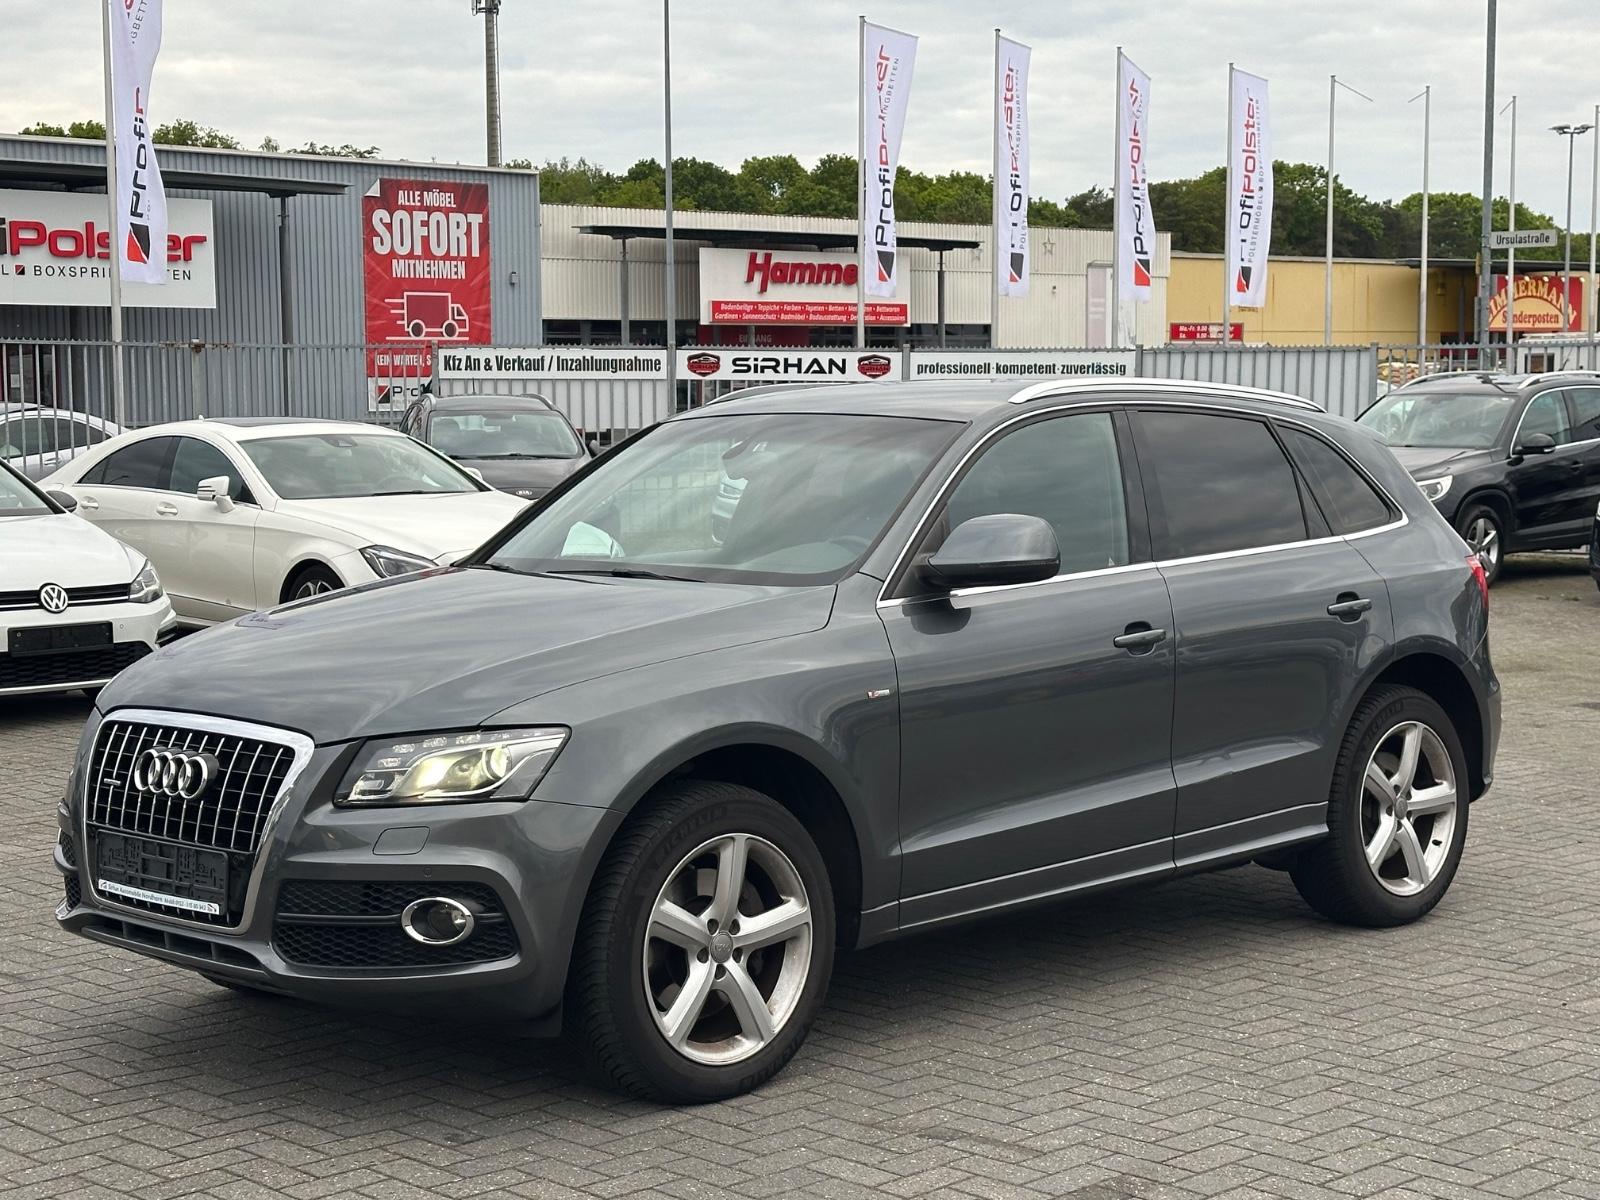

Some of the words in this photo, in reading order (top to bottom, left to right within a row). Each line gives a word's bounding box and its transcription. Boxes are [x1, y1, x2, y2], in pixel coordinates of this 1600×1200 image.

[398, 190, 421, 206] ALLE
[423, 188, 457, 208] MÖBEL
[372, 209, 483, 258] SOFORT
[1496, 232, 1551, 246] Ursulastraße
[391, 259, 466, 279] MITNEHMEN
[746, 251, 859, 293] Hamme
[714, 312, 739, 320] Gardinen
[757, 303, 780, 312] Teppiche
[1502, 311, 1559, 326] Snderposten
[443, 354, 462, 371] Kfz
[464, 354, 481, 372] An
[483, 356, 493, 372] &
[495, 355, 546, 372] Verkauf
[547, 354, 554, 372] /
[556, 355, 662, 374] Inzahlungnahme
[917, 362, 991, 376] professionell
[995, 362, 1057, 376] kompetent
[1060, 361, 1127, 376] zuverlässig
